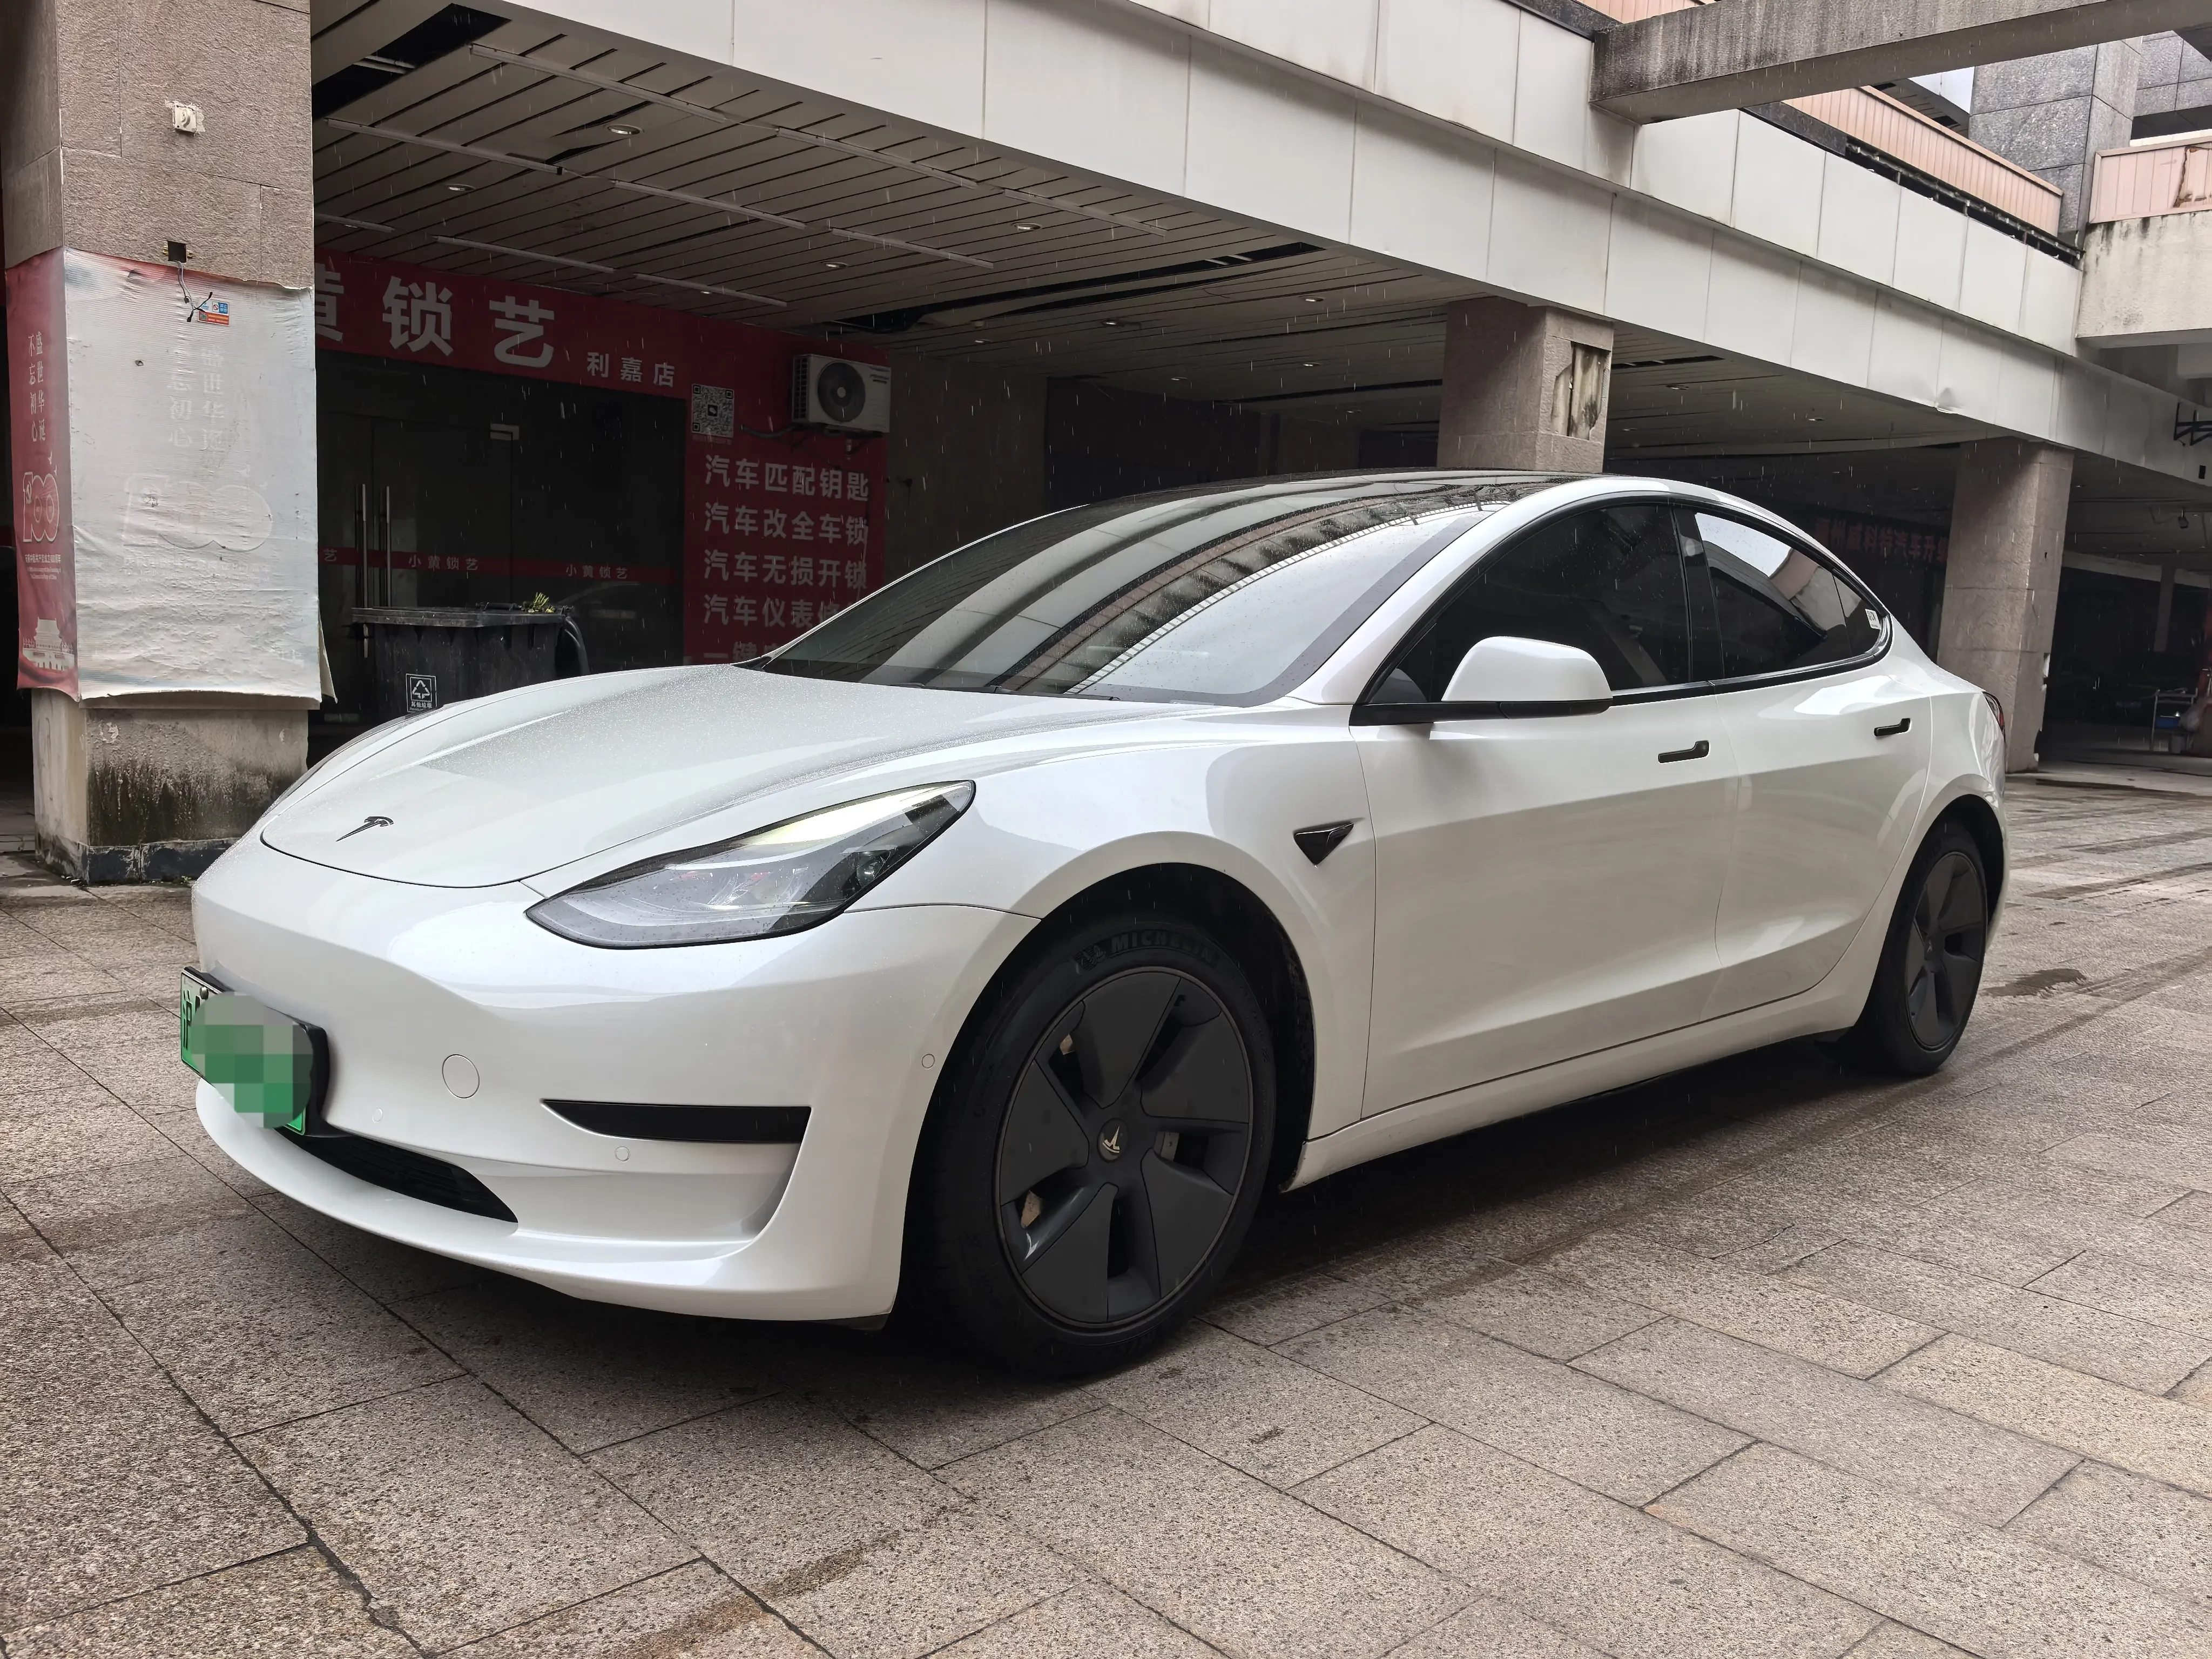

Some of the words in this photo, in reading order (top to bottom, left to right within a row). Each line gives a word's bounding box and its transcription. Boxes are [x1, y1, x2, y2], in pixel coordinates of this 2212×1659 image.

[28, 333, 38, 443] 不忘初心
[587, 352, 675, 388] 利嘉店
[705, 454, 869, 502] 汽车匹配钥匙
[704, 502, 869, 545] 汽车改全车锁
[408, 555, 478, 571] 小黄锁艺
[565, 565, 628, 580] 小黄锁艺
[704, 549, 868, 589] 汽车无损开锁
[704, 594, 855, 629] 汽车仪表修
[1111, 929, 1215, 964] MICHELIN
